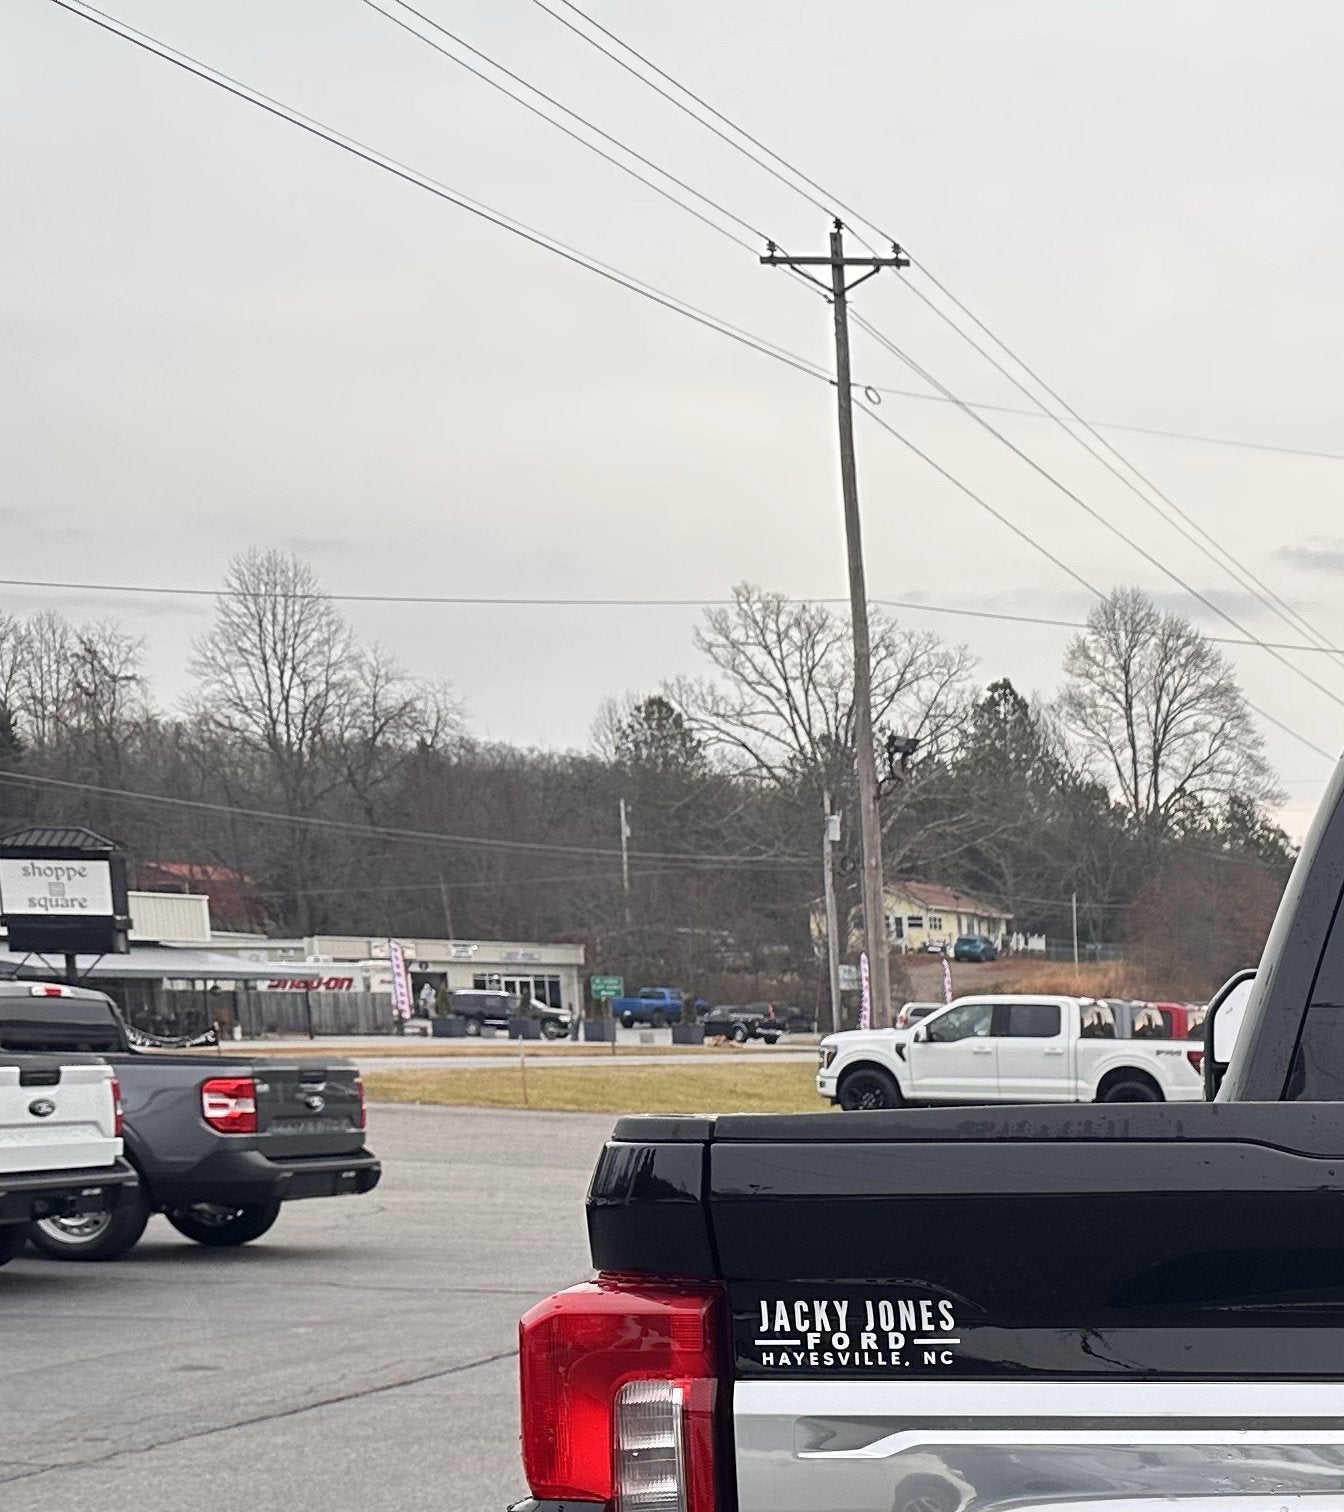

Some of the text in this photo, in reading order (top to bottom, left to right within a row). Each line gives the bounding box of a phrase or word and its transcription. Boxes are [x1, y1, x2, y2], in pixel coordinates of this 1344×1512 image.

[21, 862, 88, 881] shoppe
[27, 896, 88, 911] square
[760, 1299, 955, 1332] JACKY JONES
[807, 1332, 905, 1349] FORD
[924, 1351, 953, 1365] NC
